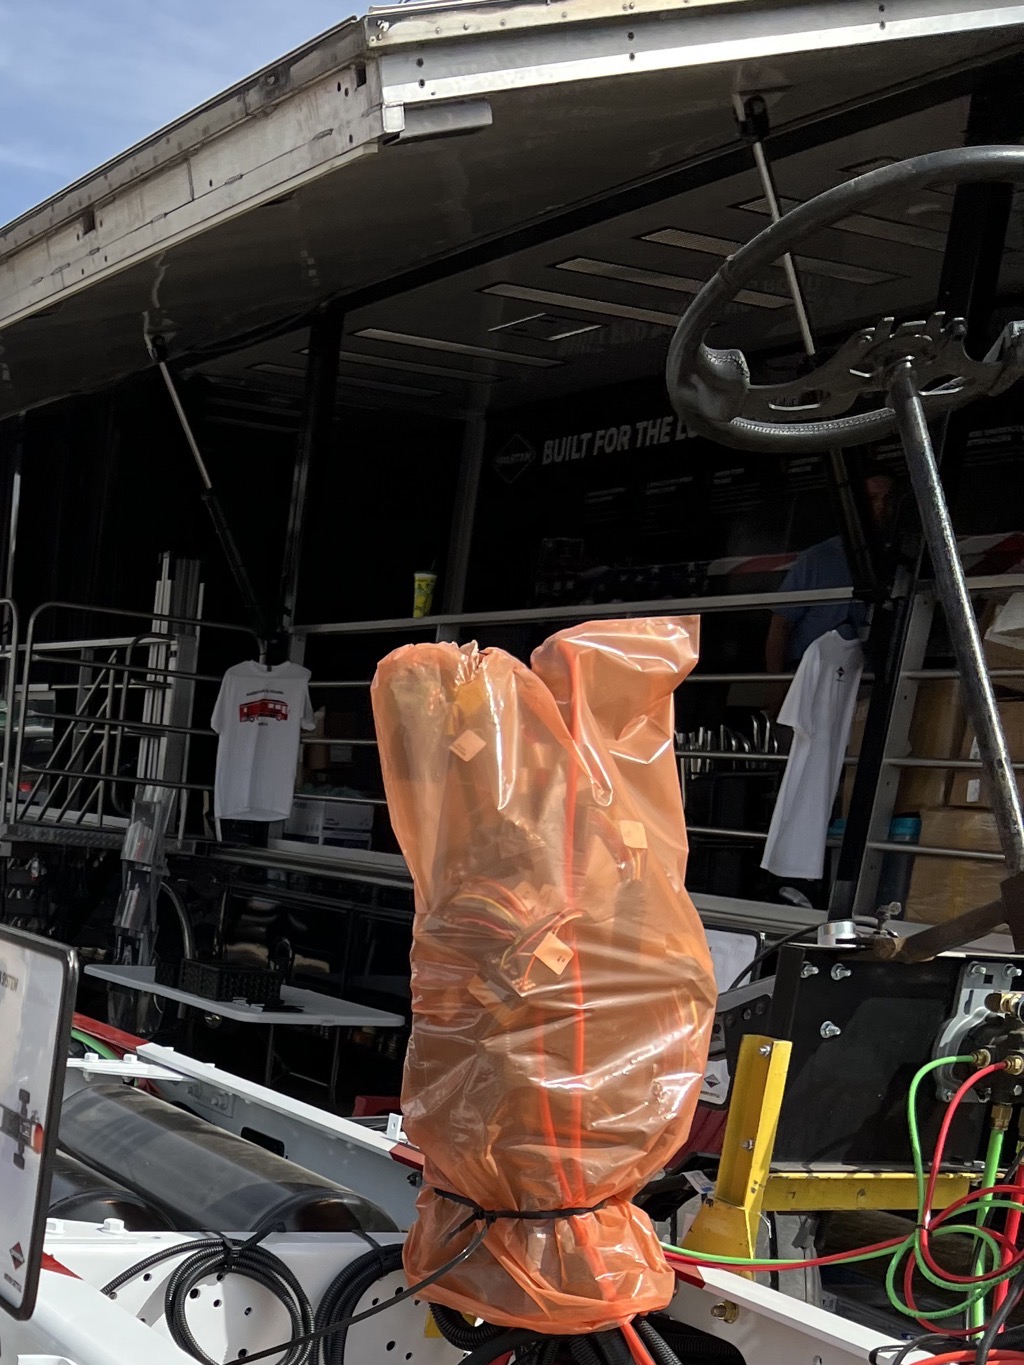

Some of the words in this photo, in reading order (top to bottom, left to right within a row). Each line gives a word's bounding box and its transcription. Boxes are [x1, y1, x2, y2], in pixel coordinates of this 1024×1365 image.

[542, 432, 593, 465] BUILT
[593, 425, 631, 456] FOR
[636, 415, 675, 449] THE
